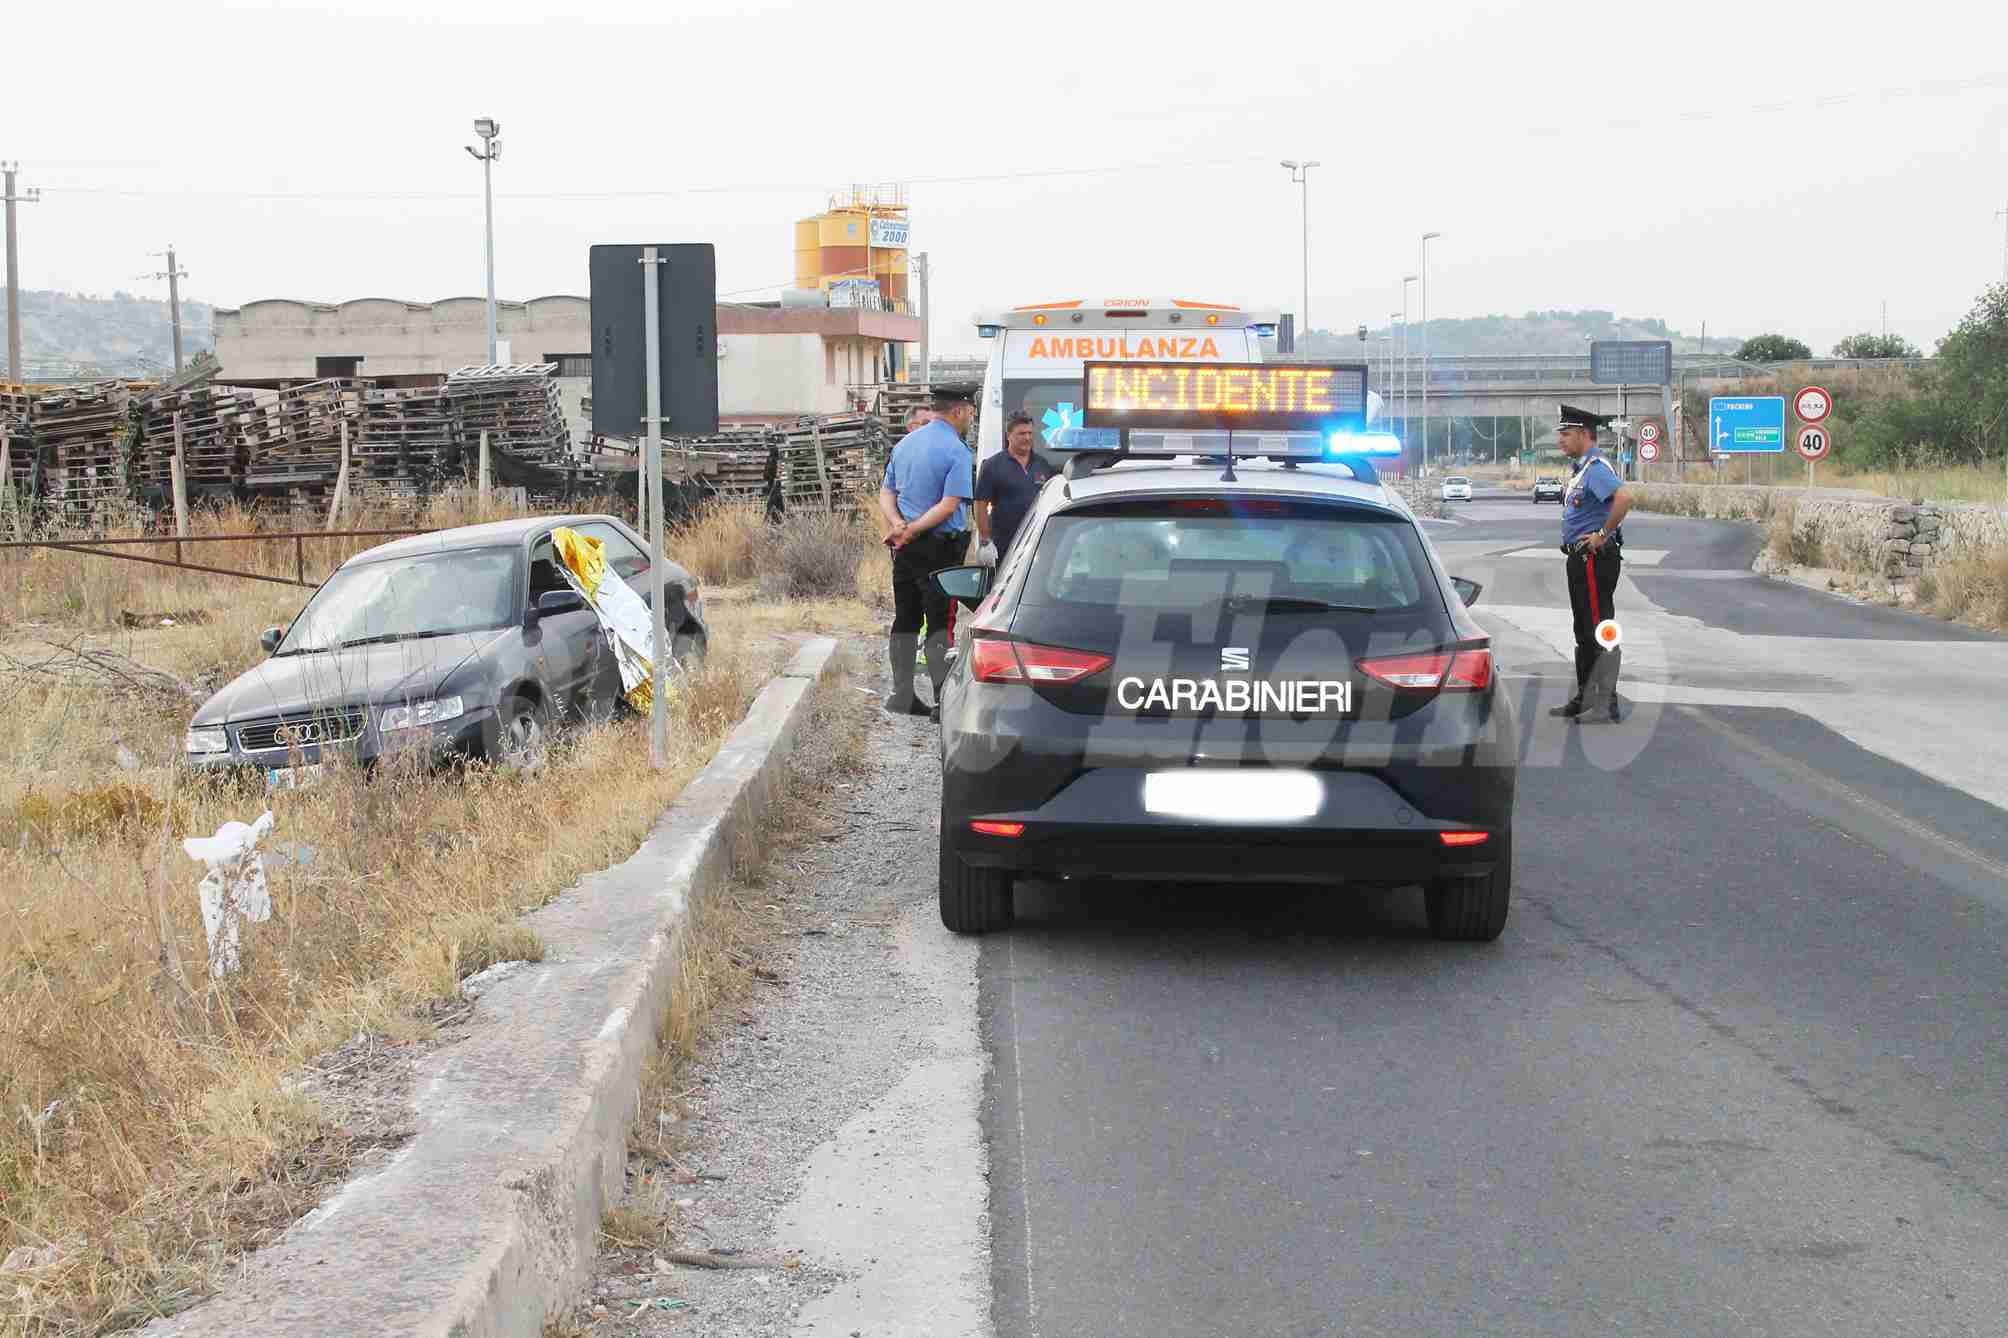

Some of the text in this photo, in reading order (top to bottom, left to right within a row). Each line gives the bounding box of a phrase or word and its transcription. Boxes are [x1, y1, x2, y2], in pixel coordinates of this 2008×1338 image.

[882, 231, 908, 243] 2000
[1028, 336, 1219, 359] AMBULANZA
[1089, 367, 1333, 412] INCIDENTE
[1643, 428, 1654, 437] 40
[1803, 434, 1822, 450] 40
[1117, 676, 1352, 713] CARABINIERI
